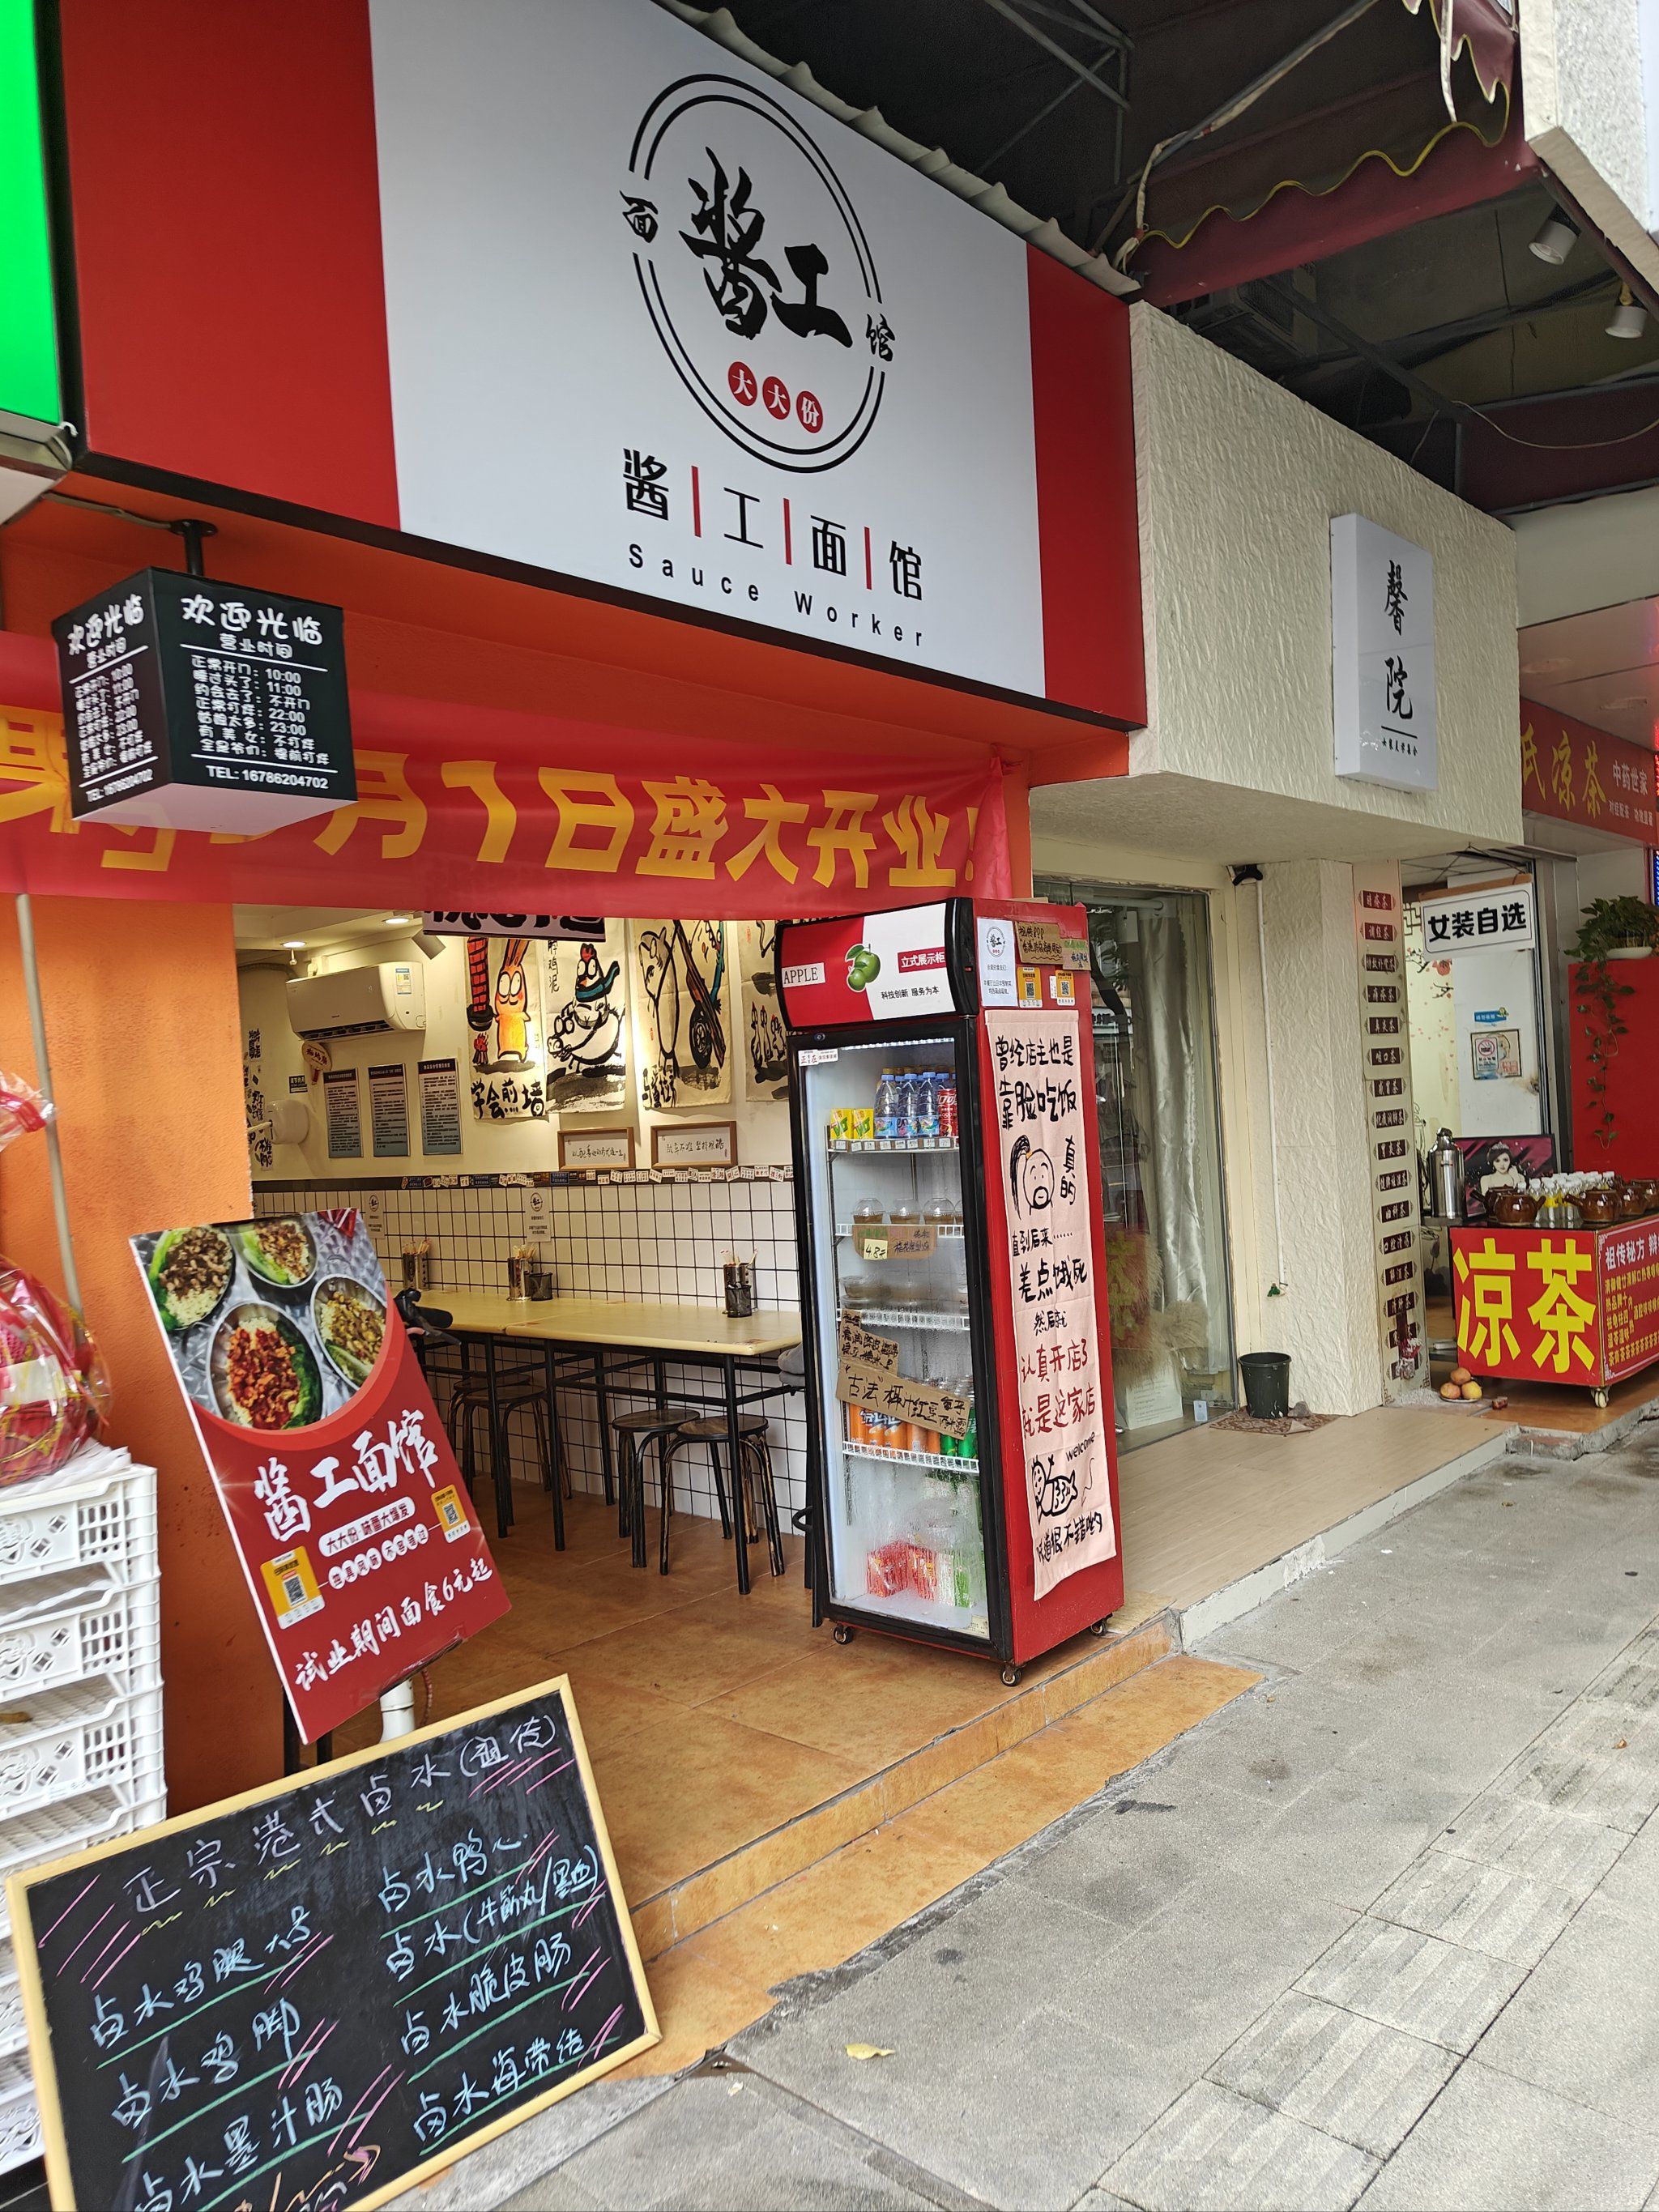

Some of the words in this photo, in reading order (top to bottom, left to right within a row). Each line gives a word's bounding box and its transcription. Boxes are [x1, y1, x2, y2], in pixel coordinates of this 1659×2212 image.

[730, 364, 822, 432] 大大份
[622, 447, 923, 602] 酱工面馆
[628, 543, 761, 602] Sauce
[794, 590, 923, 647] Worker
[180, 593, 324, 646] 欢迎光临
[219, 632, 294, 659] 营业时间
[264, 667, 302, 684] 10:00
[266, 681, 302, 697] 11:00
[268, 694, 311, 711] 不开门
[268, 707, 306, 723] 22:00
[269, 720, 307, 736] 23:00
[205, 765, 241, 780] TEL:
[1427, 901, 1527, 944] 女装自选
[783, 965, 819, 986] APPLE
[900, 952, 946, 969] 立式展示柜
[881, 987, 909, 1001] 科技创新
[911, 985, 940, 998] 服务为本
[995, 1034, 1075, 1072] 曾经店主也是
[998, 1075, 1077, 1132] 靠脸吃饭
[1060, 1134, 1077, 1206] 真的
[1605, 1237, 1645, 1272] 祖传秘方
[1017, 1255, 1088, 1303] 差点饿死
[1033, 1309, 1068, 1337] 然后就
[1452, 1238, 1597, 1374] 凉茶
[1021, 1338, 1089, 1384] 认真开店了
[1021, 1382, 1096, 1442] 就是这家店
[1065, 1430, 1096, 1463] welcome
[252, 1409, 439, 1544] 酱工面馆
[293, 1555, 493, 1693] 试业期间面食6元起
[399, 1937, 573, 2057] 卤水脆皮肠
[110, 1997, 301, 2130] 卤水鸡脚
